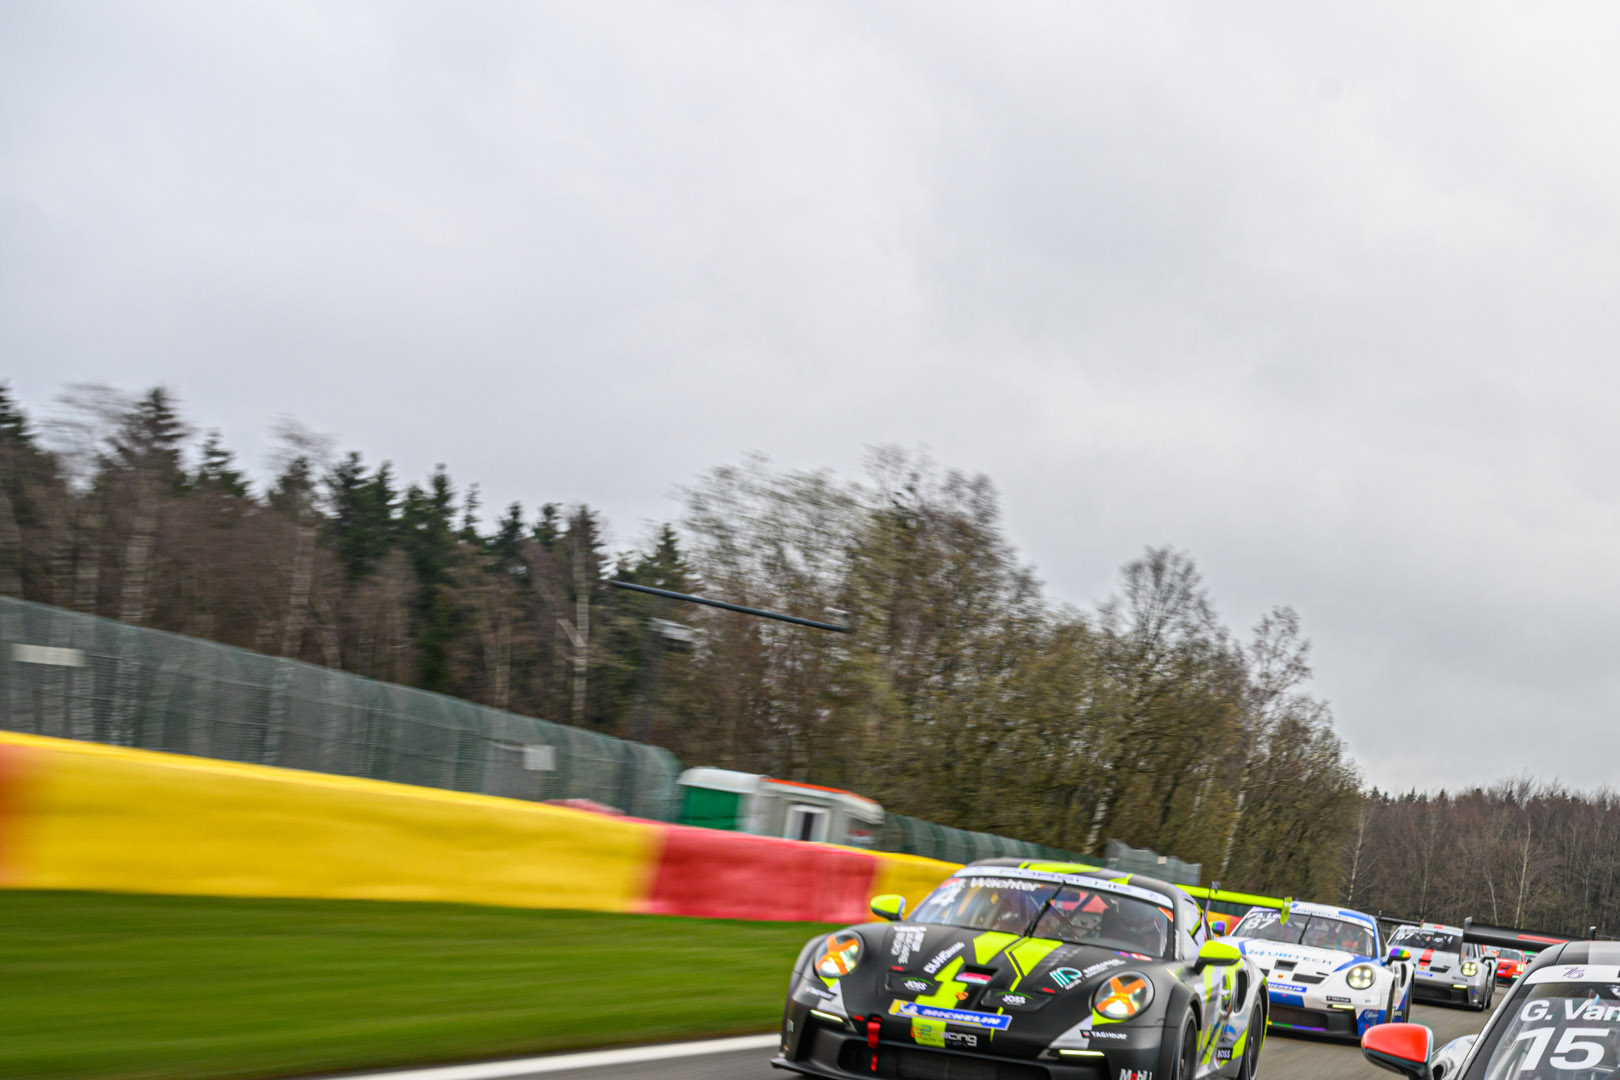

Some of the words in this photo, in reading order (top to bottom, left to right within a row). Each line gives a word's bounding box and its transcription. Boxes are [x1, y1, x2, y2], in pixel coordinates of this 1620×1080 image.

[1245, 918, 1276, 929] 87
[1002, 994, 1027, 1005] JOSS
[922, 1008, 1001, 1025] MICHELIN
[1520, 999, 1552, 1022] G.
[1517, 1027, 1610, 1071] 15
